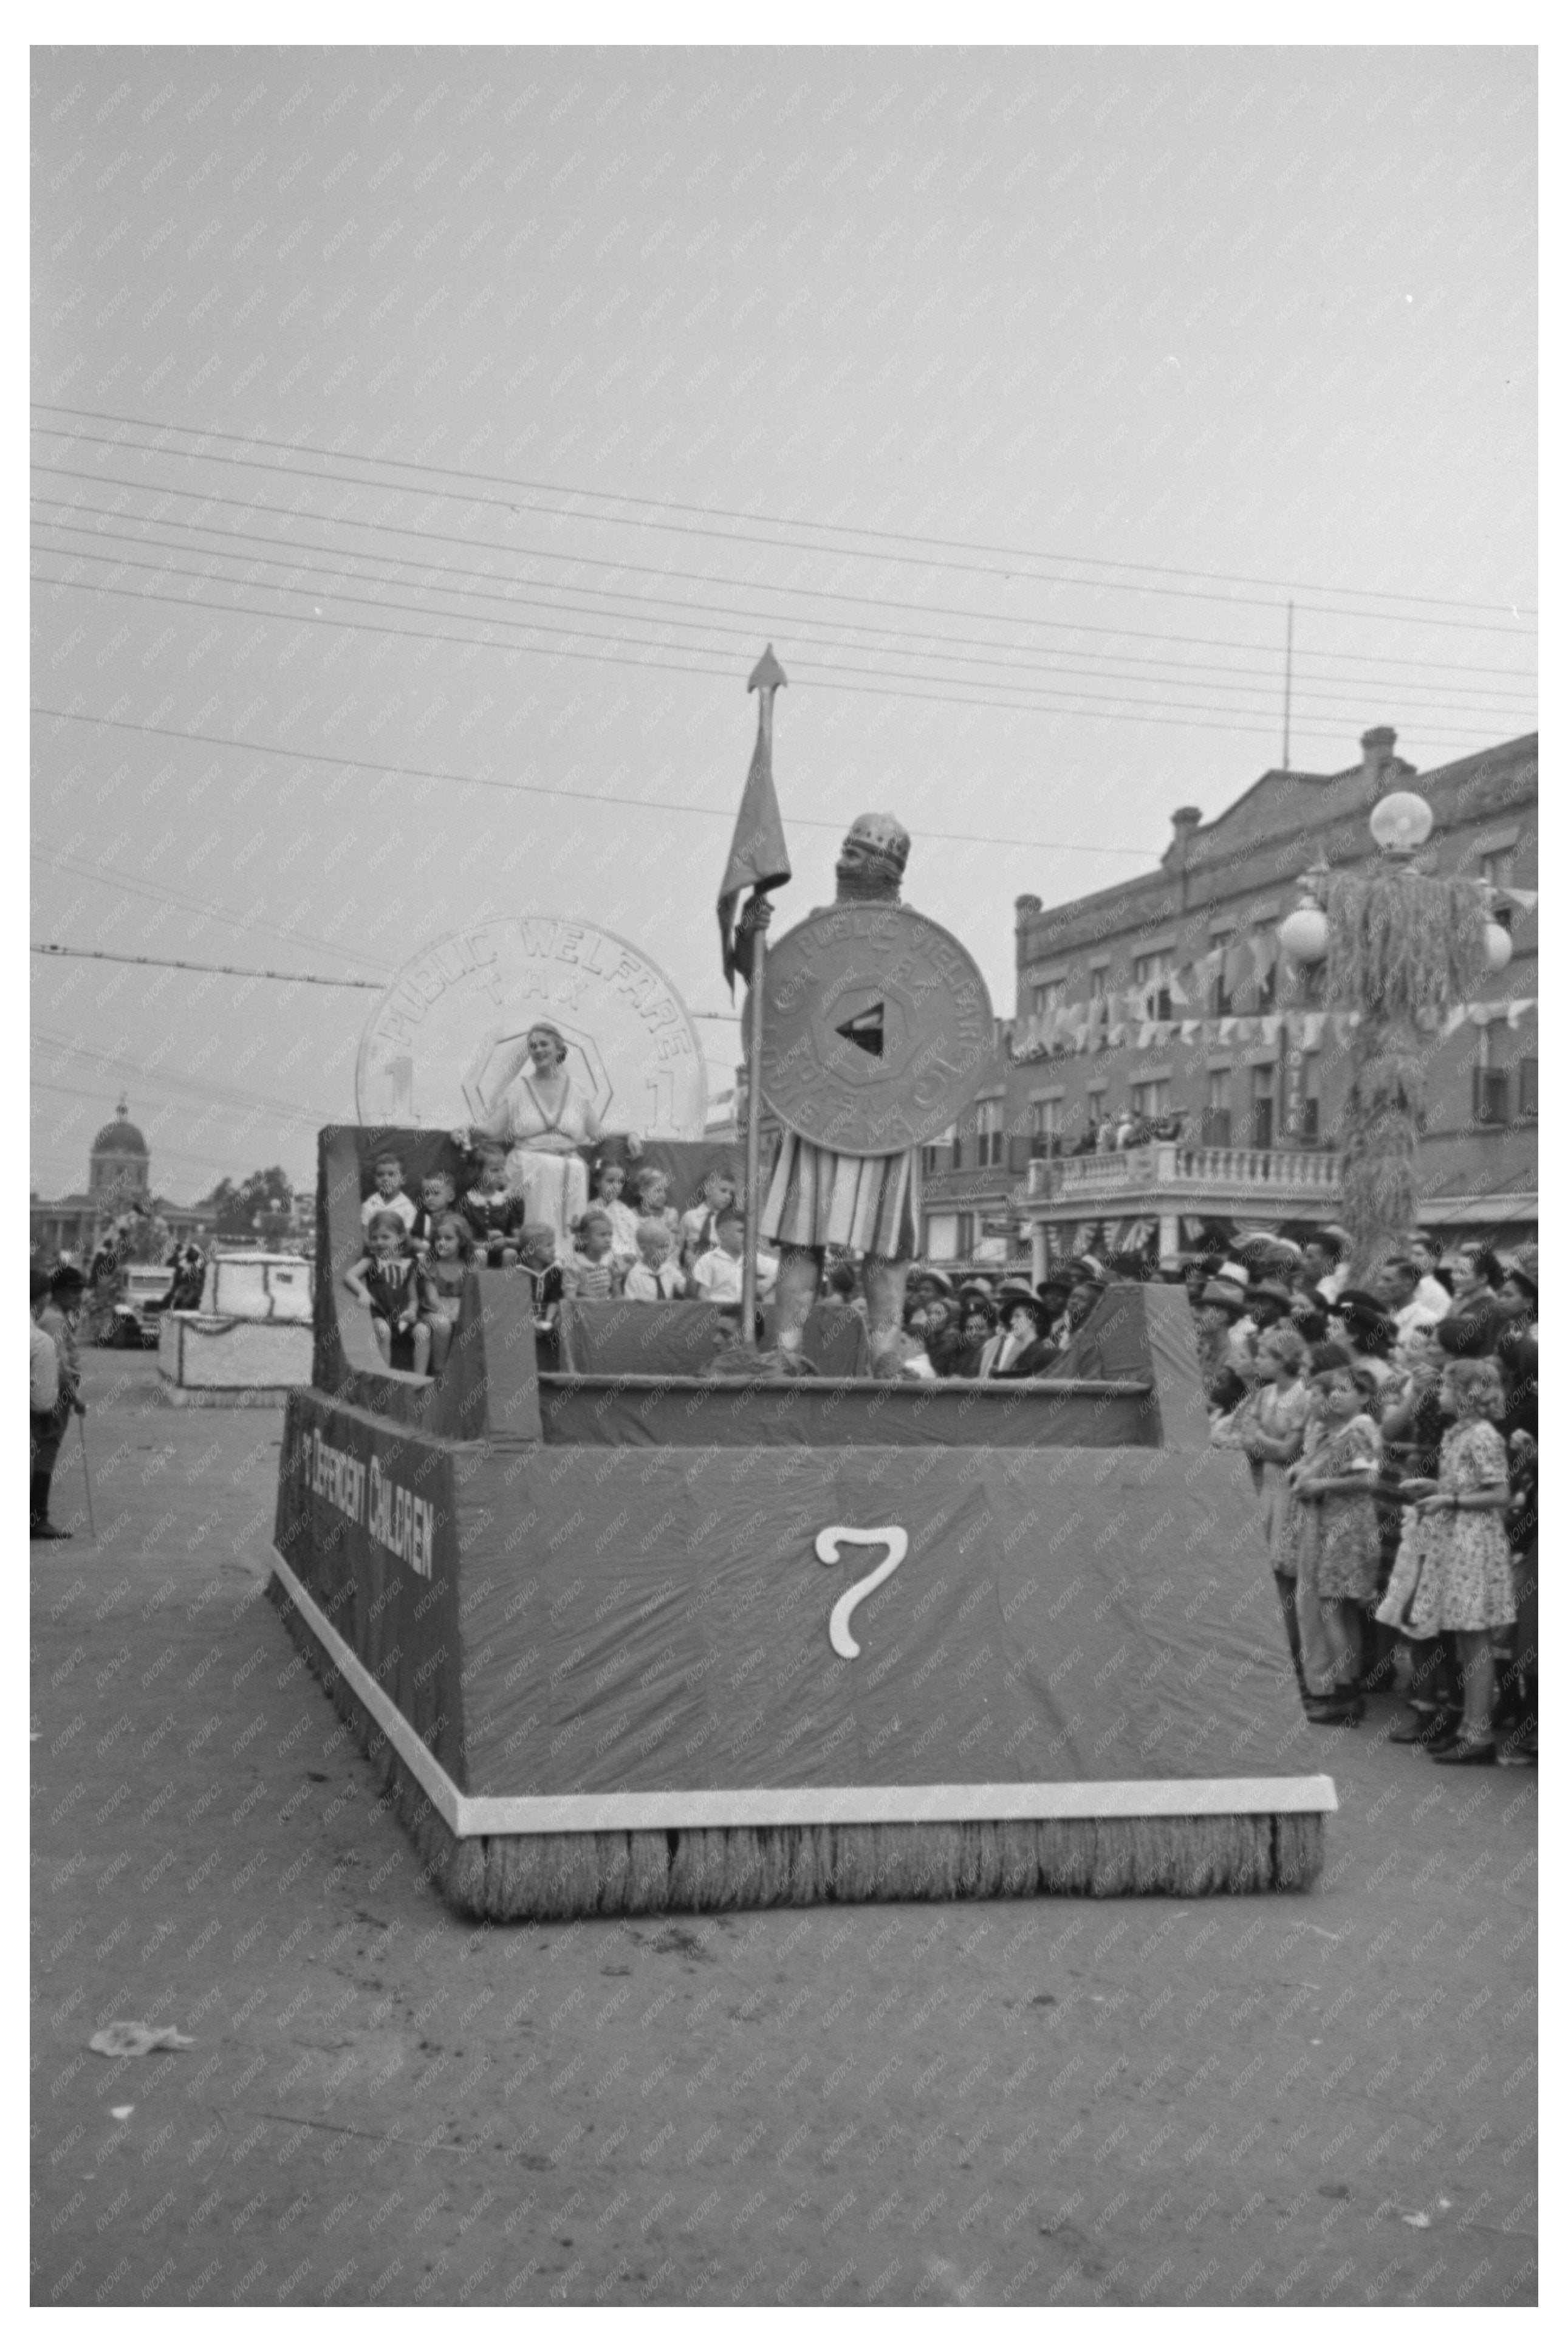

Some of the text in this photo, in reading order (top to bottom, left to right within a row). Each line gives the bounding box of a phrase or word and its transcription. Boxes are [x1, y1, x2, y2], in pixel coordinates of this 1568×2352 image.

[377, 921, 693, 1061] PUBLIC WELFARE
[476, 969, 589, 1011] TAX
[383, 1056, 421, 1125] 1
[645, 1070, 681, 1139] 1
[1287, 1049, 1302, 1131] OTEL
[312, 1428, 366, 1526] DEPENDENT
[369, 1455, 433, 1581] CHILDREN
[815, 1526, 908, 1659] 7
